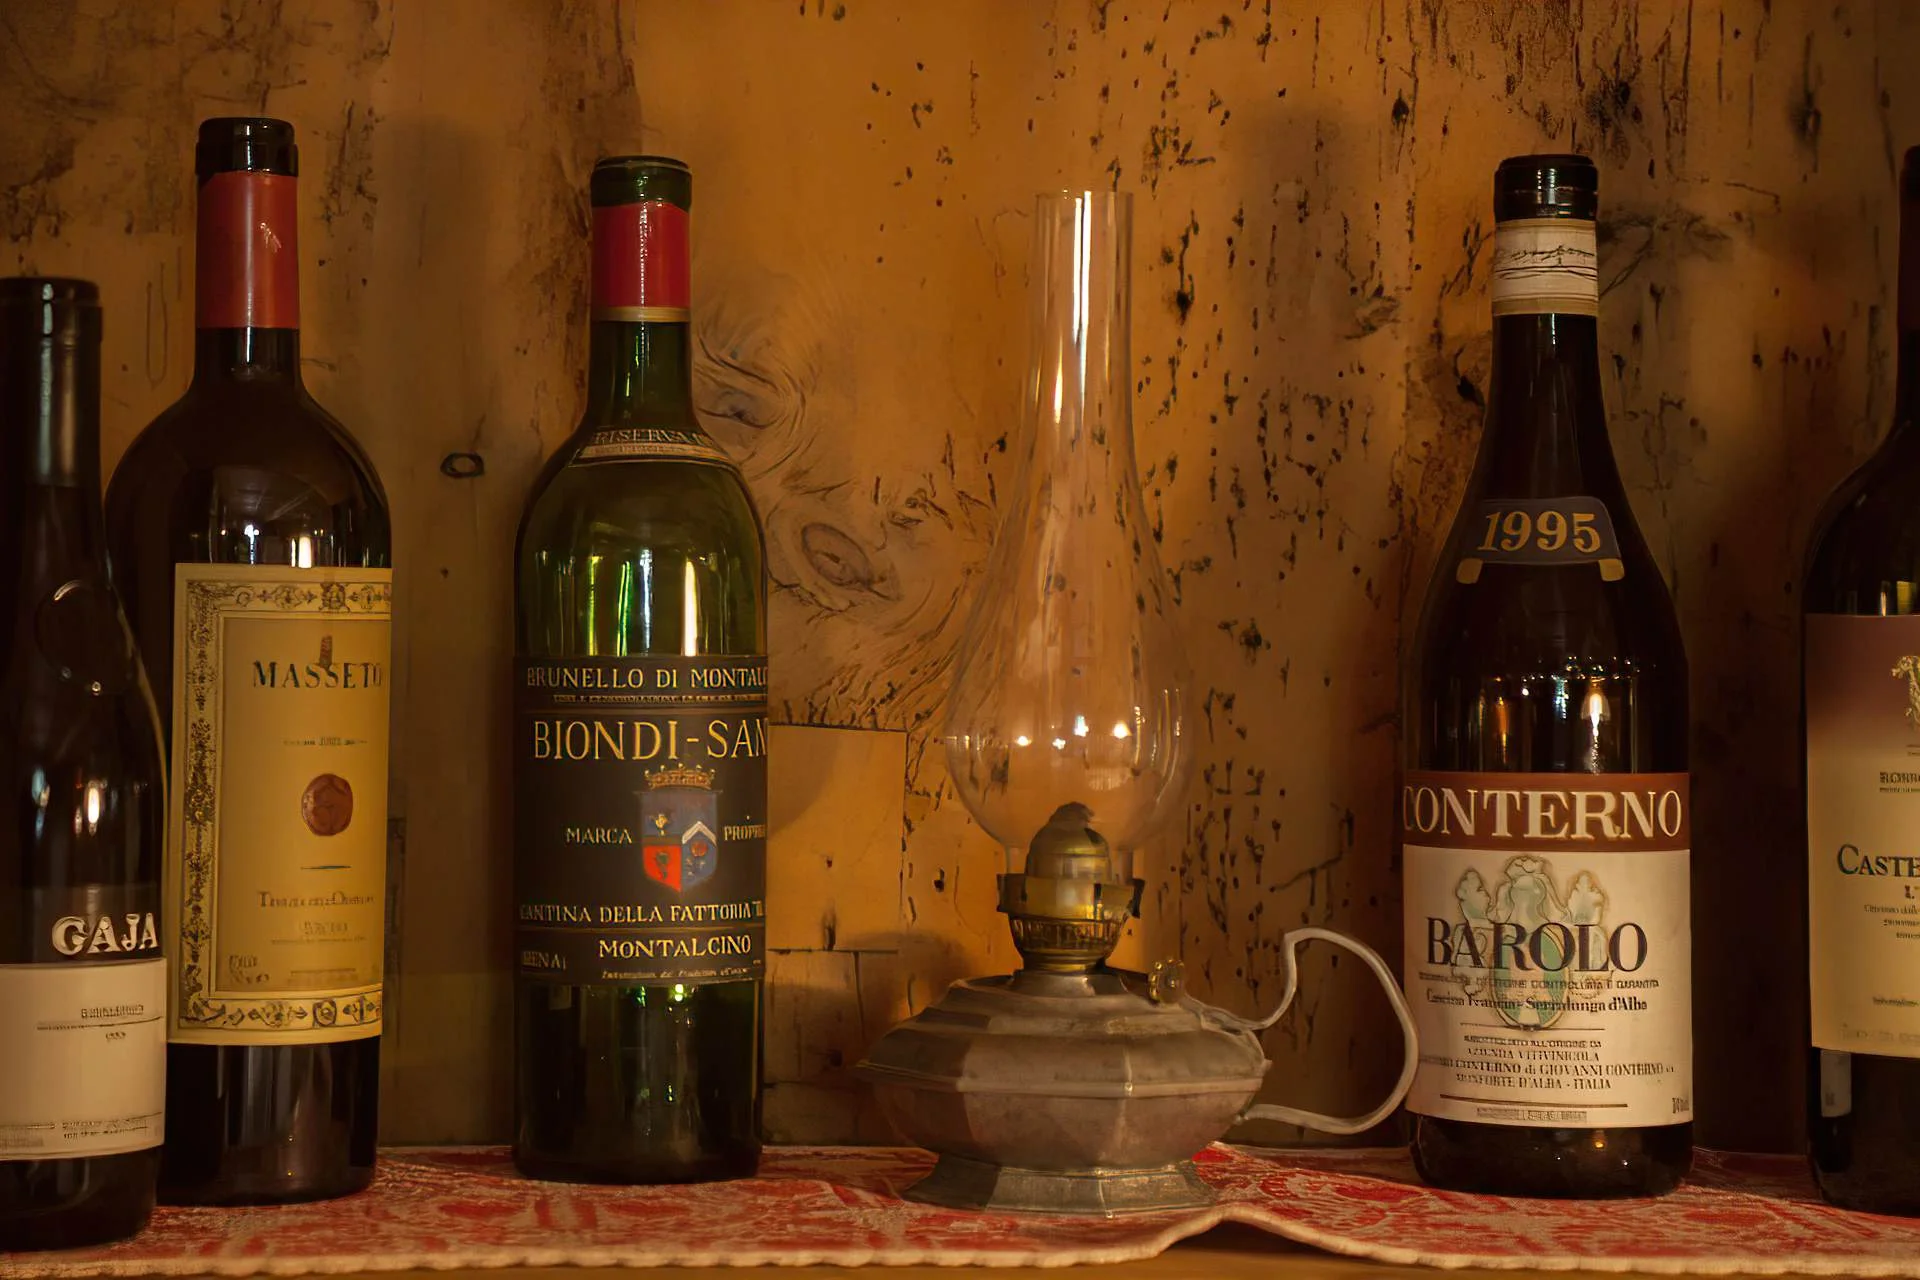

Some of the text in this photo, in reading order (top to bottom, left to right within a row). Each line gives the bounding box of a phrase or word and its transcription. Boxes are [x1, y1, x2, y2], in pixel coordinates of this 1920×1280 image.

[1477, 510, 1601, 553] 1995
[253, 660, 382, 689] MASSETO
[527, 666, 644, 689] BRUNELLO
[656, 668, 678, 688] DI
[1403, 785, 1682, 840] CONTERNO
[565, 827, 633, 845] MARCA
[521, 904, 592, 922] CANTINA
[599, 904, 663, 923] DELLA
[51, 912, 159, 955] GAJA
[599, 934, 751, 959] MONTALCINO
[1426, 916, 1648, 972] BAROLO
[1540, 1064, 1602, 1077] GIOVANNI
